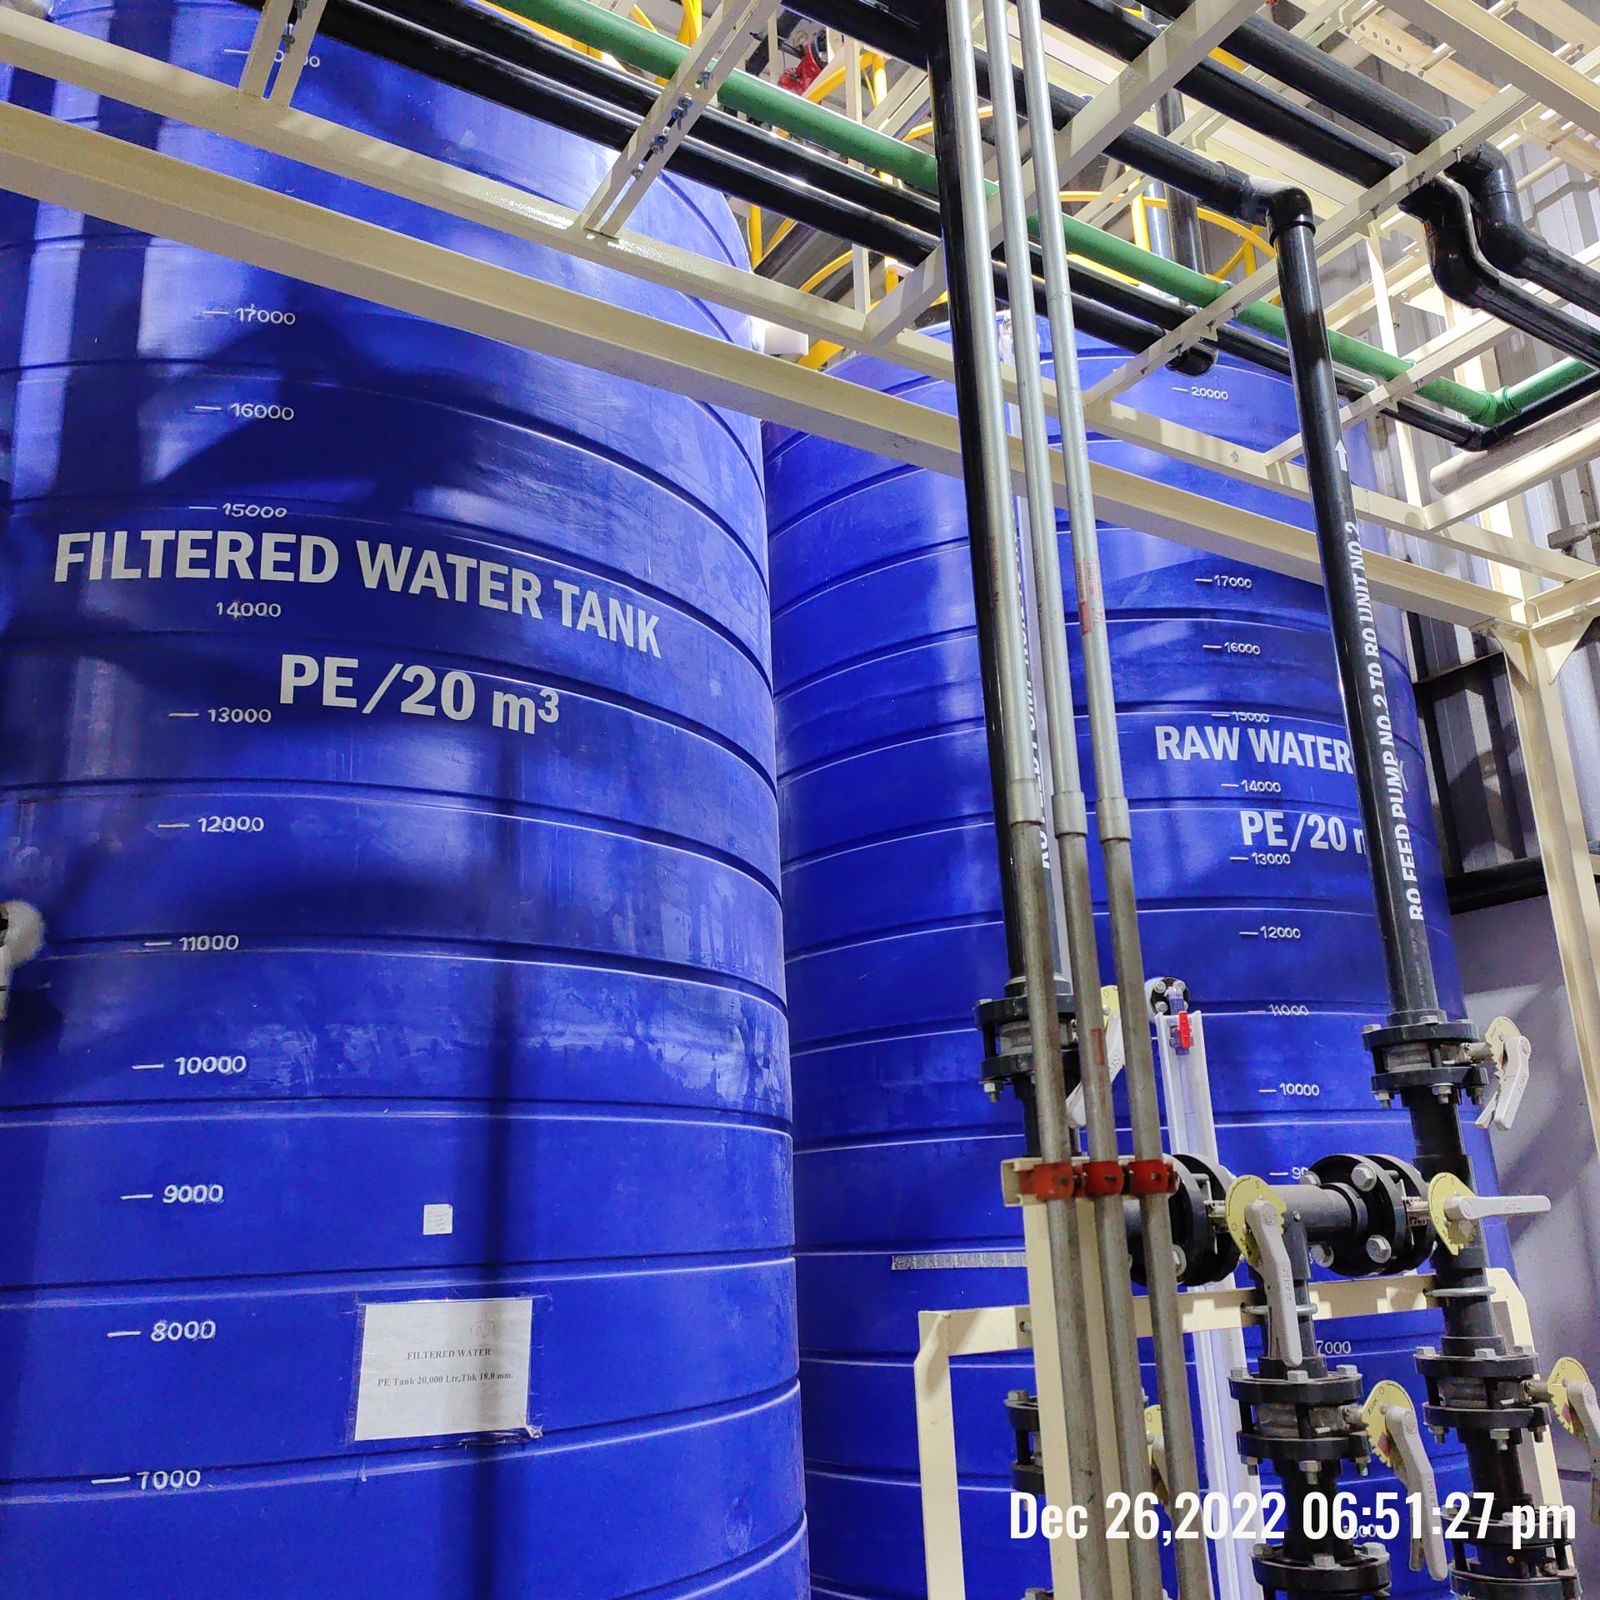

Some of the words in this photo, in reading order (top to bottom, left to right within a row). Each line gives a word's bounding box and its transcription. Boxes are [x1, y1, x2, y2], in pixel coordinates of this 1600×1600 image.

[234, 304, 296, 325] 17000
[1191, 386, 1229, 401] 20000
[228, 402, 295, 421] 16000
[223, 503, 288, 519] 15000
[1213, 575, 1253, 589] 17000
[54, 529, 339, 583] FILTERED
[356, 540, 543, 620] WATER
[554, 579, 661, 659] TANK
[1353, 572, 1374, 623] UNIT
[216, 601, 282, 619] 14000
[1224, 641, 1261, 655] 16000
[1361, 627, 1381, 658] RO
[1367, 662, 1385, 690] TO
[207, 706, 272, 724] 13000
[1231, 710, 1270, 724] 15000
[1154, 725, 1240, 761] RAW
[1247, 727, 1354, 775] WATER
[1240, 779, 1282, 793] 14000
[1383, 750, 1407, 819] PUMP
[197, 815, 265, 833] 12000
[1251, 852, 1291, 865] 13000
[1394, 823, 1418, 882] FEED
[1408, 887, 1424, 921] RO
[1260, 925, 1301, 939] 12000
[179, 934, 240, 952] 11000
[1268, 1004, 1310, 1016] 11000
[175, 1055, 247, 1076] 10000
[1279, 1083, 1320, 1097] 10000
[162, 1184, 224, 1204] 9000
[150, 1320, 216, 1342] 8000
[407, 1350, 455, 1360] FILTERED
[457, 1348, 492, 1357] WATER
[1315, 1340, 1352, 1355] 7000
[378, 1378, 391, 1387] PE
[393, 1376, 415, 1386] Tank
[136, 1469, 201, 1491] 7000
